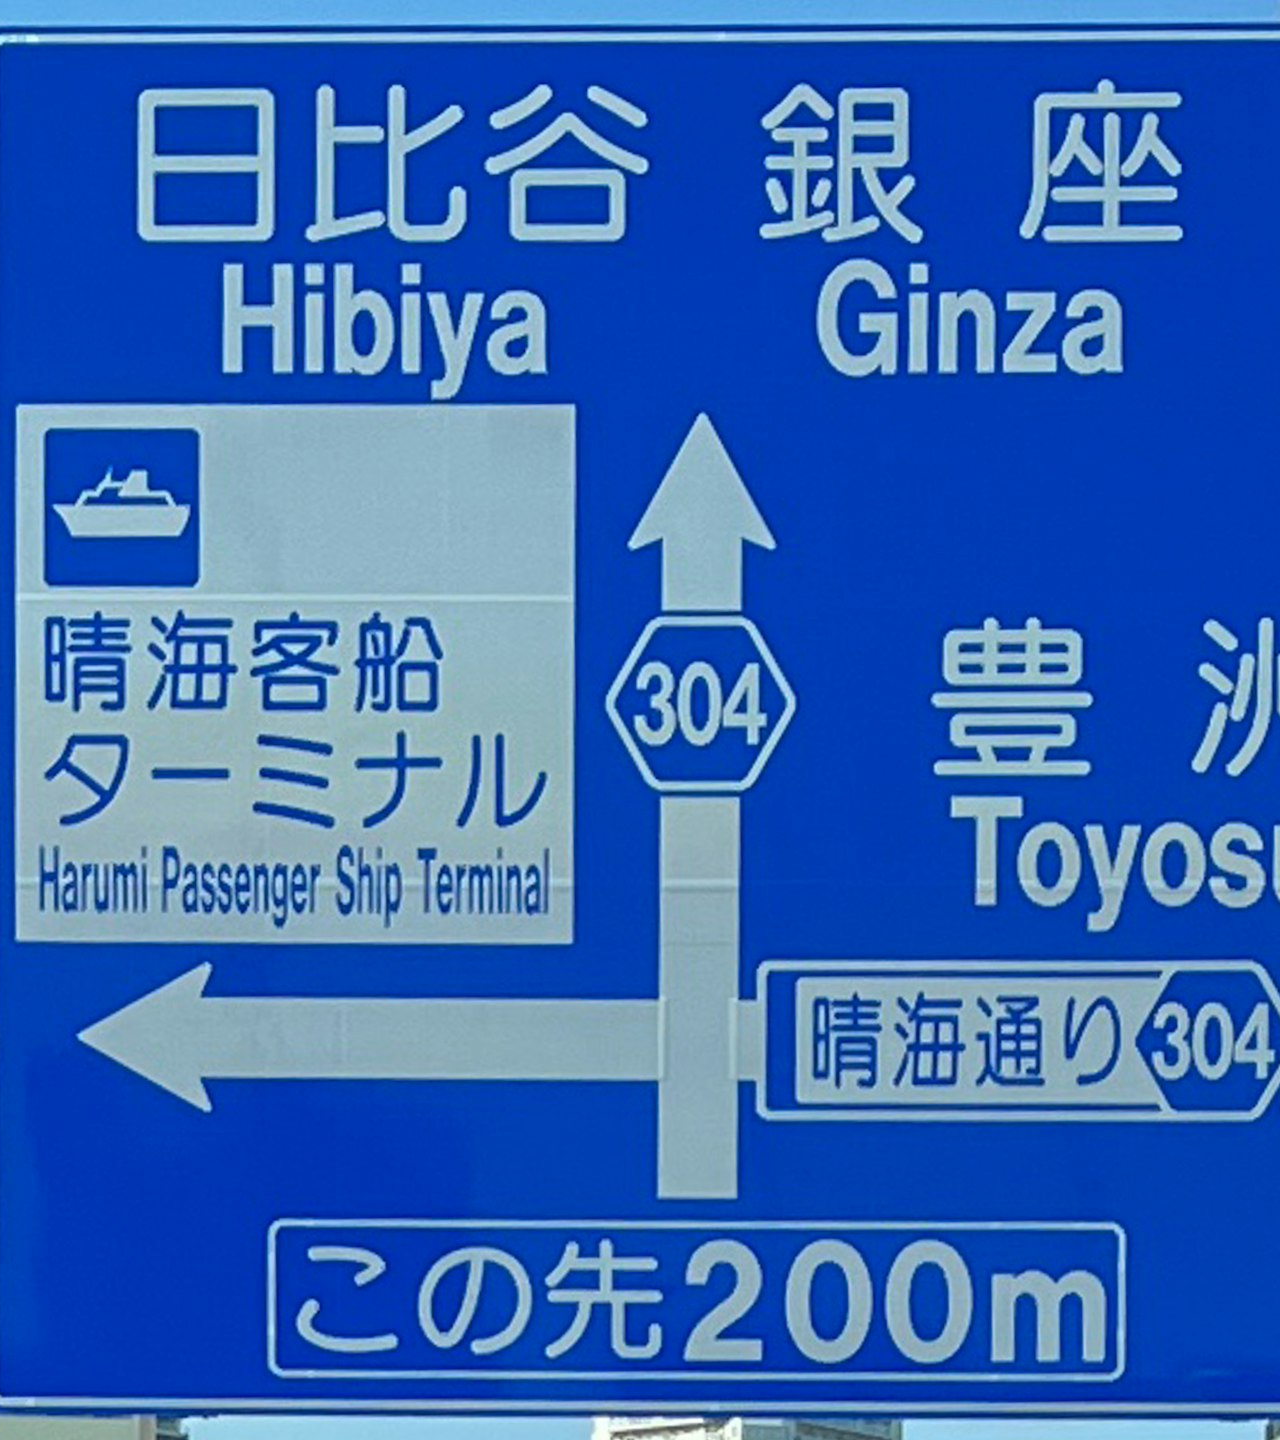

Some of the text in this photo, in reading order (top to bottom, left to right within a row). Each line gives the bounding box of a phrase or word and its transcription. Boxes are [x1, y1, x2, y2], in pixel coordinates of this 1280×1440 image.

[137, 84, 649, 242] 日比谷
[759, 79, 1183, 244] 銀座
[222, 263, 548, 400] Hibiya
[816, 259, 1124, 377] Ginza
[43, 609, 444, 714] 晴海客船
[632, 660, 768, 748] 304
[43, 730, 549, 829] ターミナル
[39, 844, 550, 929] Harumi Passenger Ship Terminal
[810, 991, 1123, 1089] 晴海通り
[1150, 1002, 1276, 1080] 304
[295, 1239, 1107, 1363] この先200m
